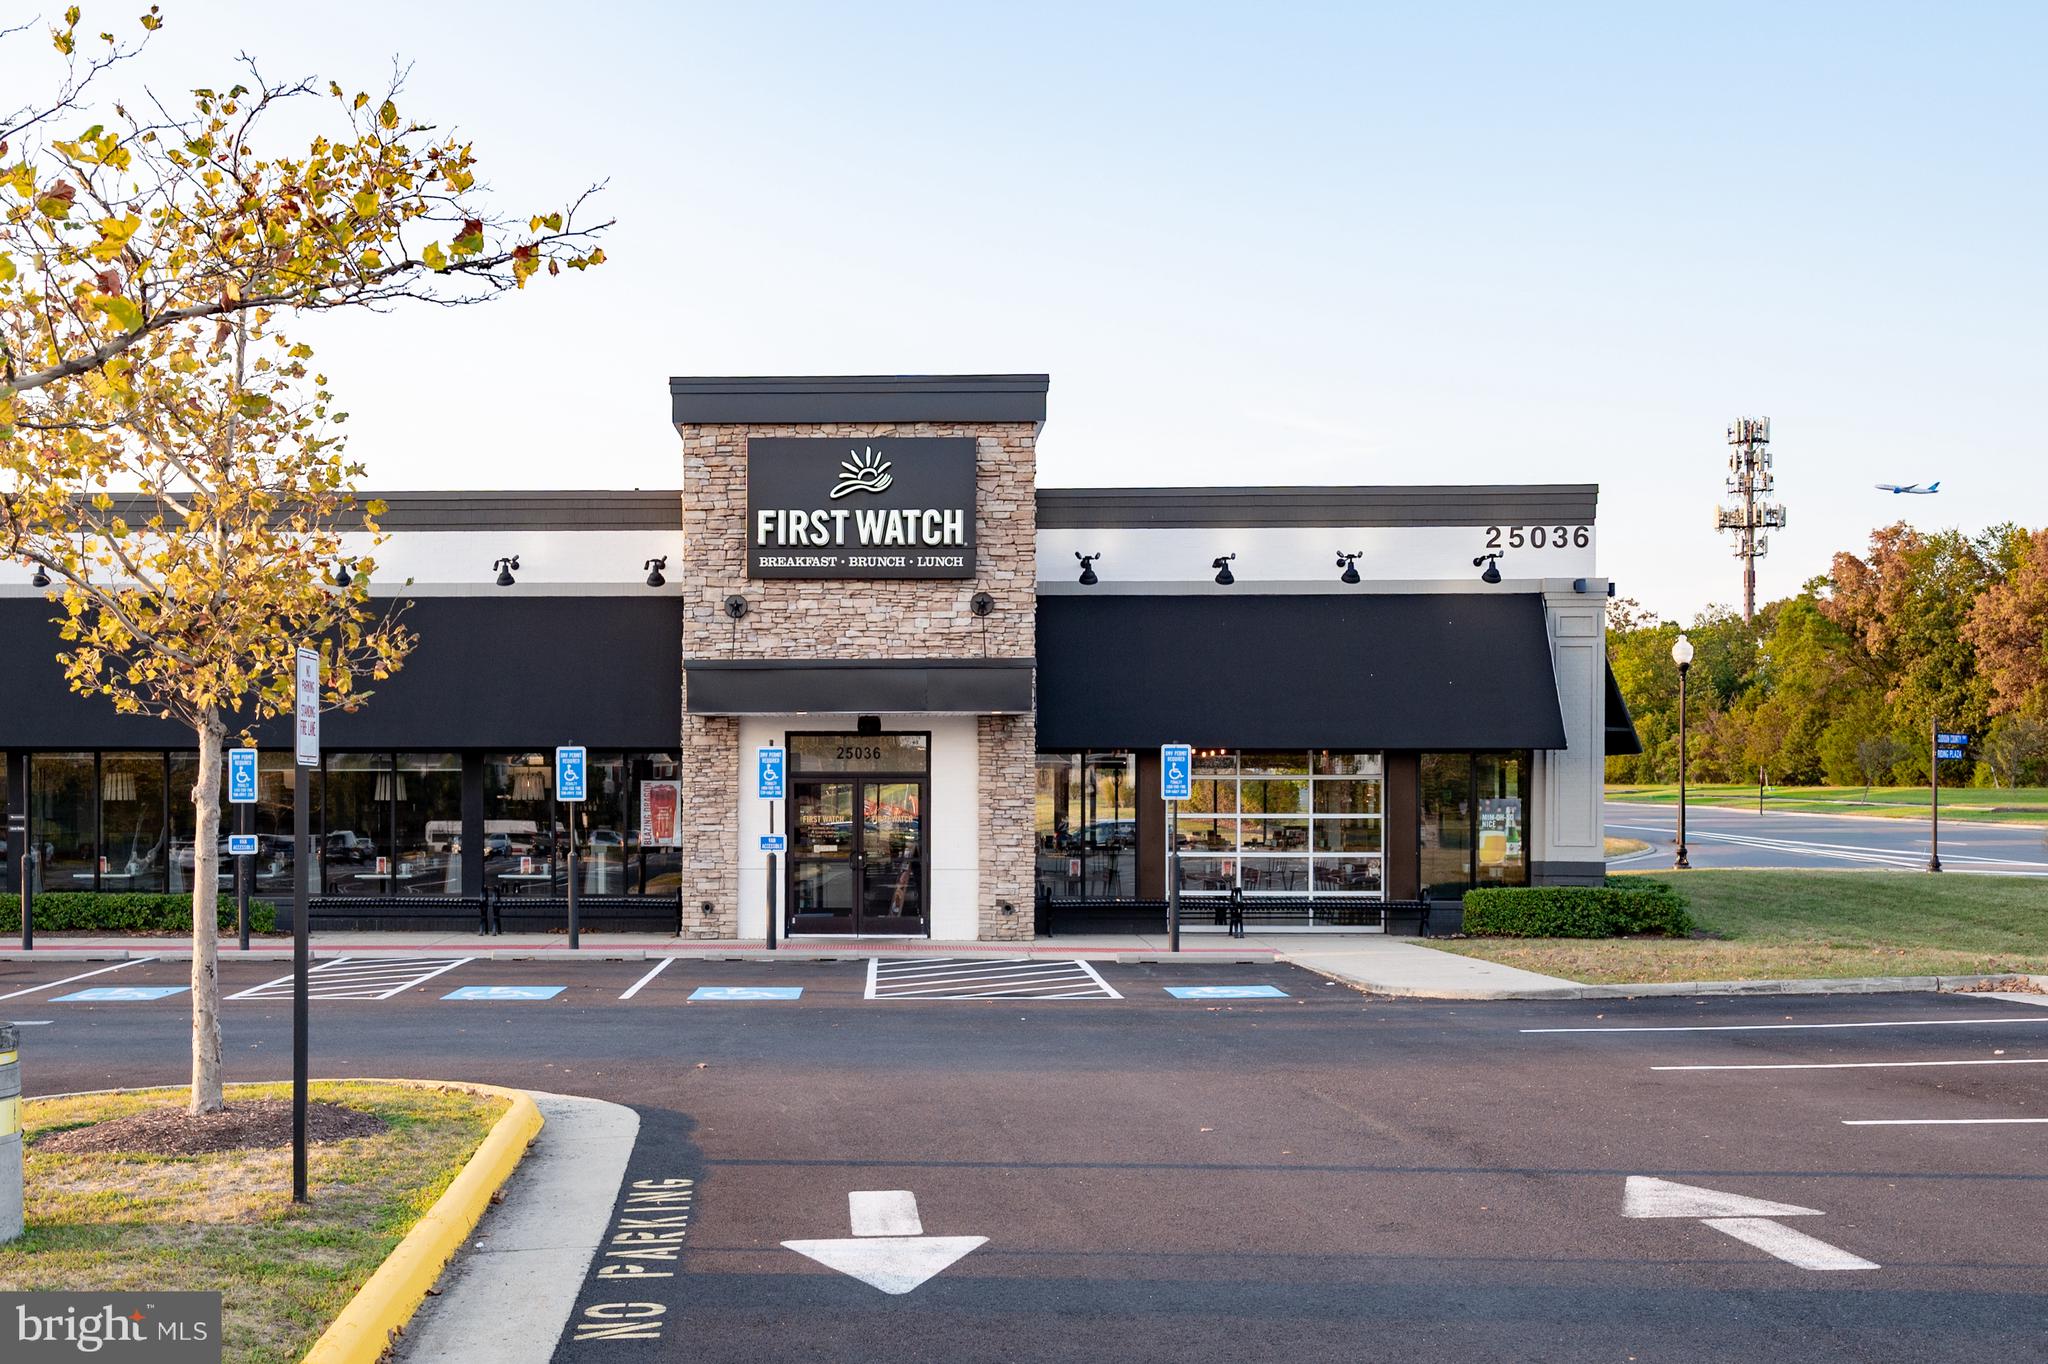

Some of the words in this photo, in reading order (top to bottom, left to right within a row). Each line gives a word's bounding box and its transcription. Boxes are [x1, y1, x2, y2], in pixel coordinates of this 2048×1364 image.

[758, 509, 850, 546] FIRST
[855, 509, 964, 546] WATCH
[1486, 525, 1589, 549] 25036
[759, 556, 837, 567] BREAKFAST
[849, 556, 905, 567] BRUNCH
[917, 556, 963, 567] LUNCH
[836, 747, 881, 760] 25036
[643, 782, 653, 813] DRAGON
[643, 814, 653, 845] BLAZING
[802, 815, 821, 823] FIRST
[822, 815, 845, 823] WATCH
[1481, 820, 1496, 828] NICE
[597, 1178, 695, 1279] PARKING
[573, 1302, 667, 1341] NO
